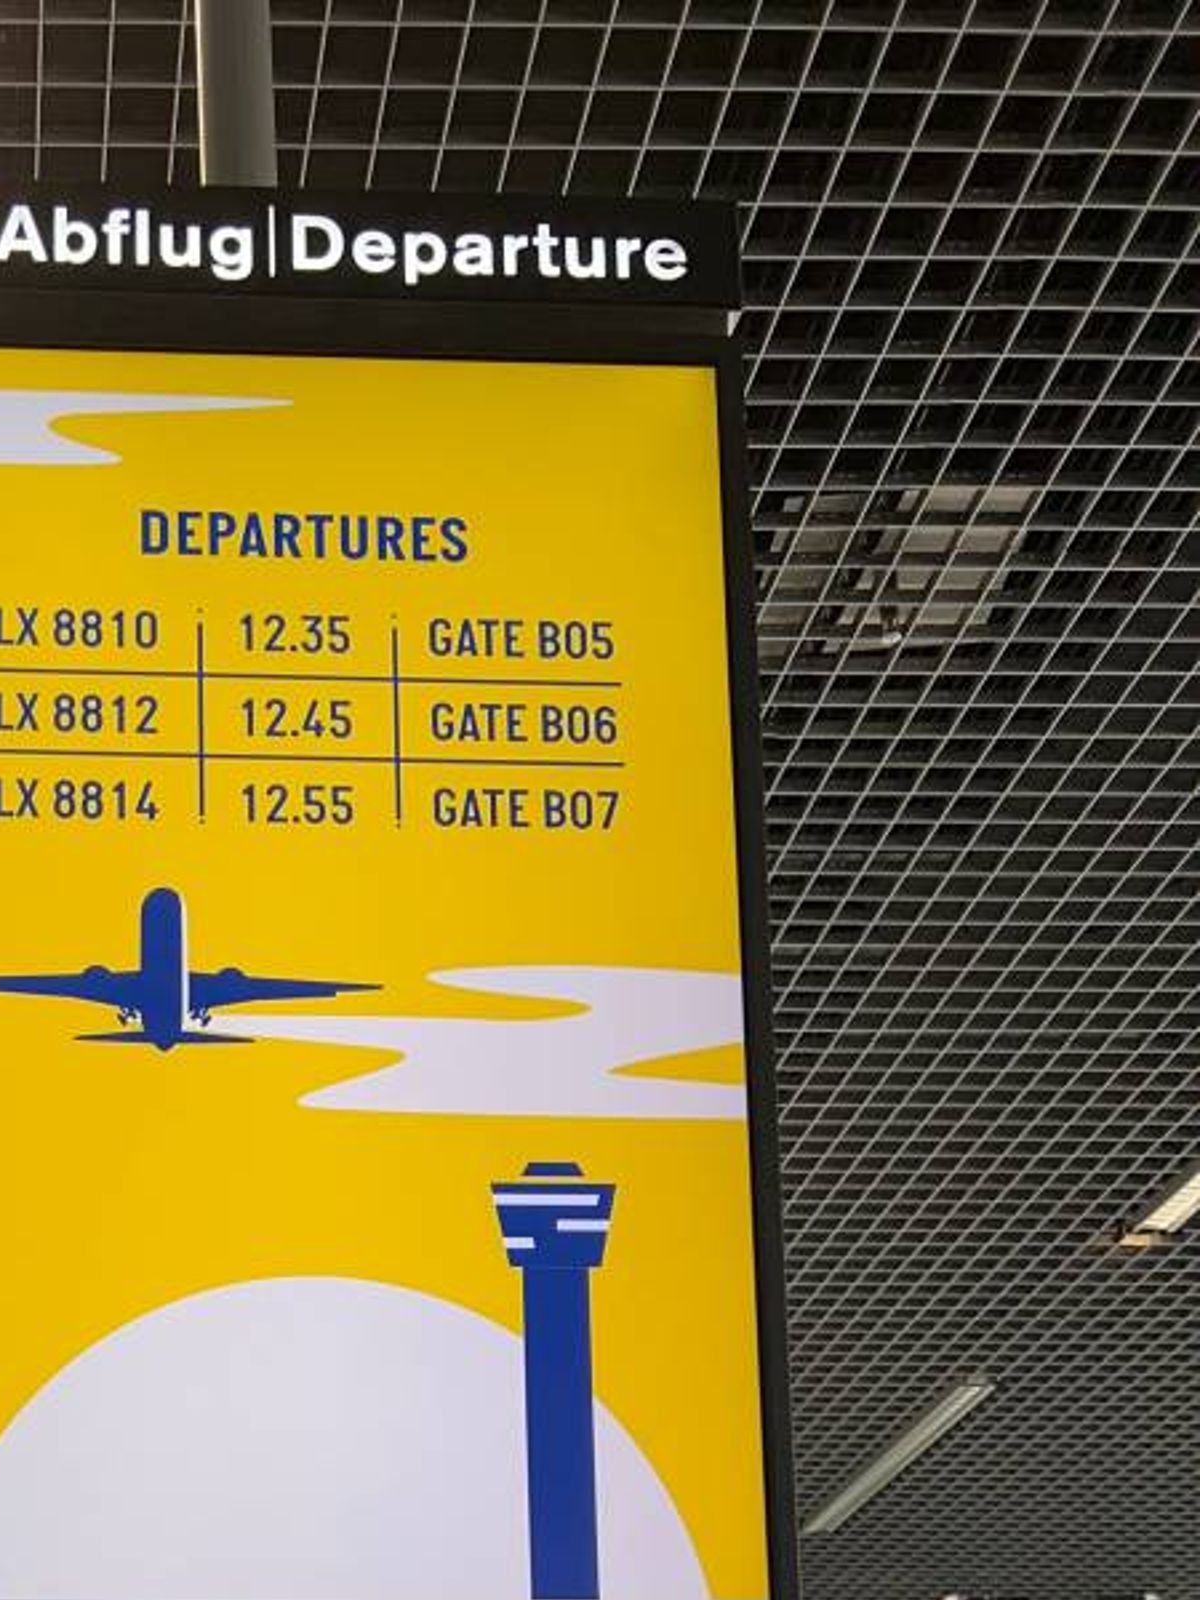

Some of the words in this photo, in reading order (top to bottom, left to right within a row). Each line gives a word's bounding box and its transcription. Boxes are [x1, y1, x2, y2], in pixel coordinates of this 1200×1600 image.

[291, 213, 689, 285] Departure
[139, 508, 469, 563] DEPARTURES
[54, 608, 158, 649] 8810
[240, 613, 350, 654] 12.35
[429, 617, 524, 658] GATE
[54, 693, 158, 734] 8812
[242, 698, 352, 739] 12.45
[431, 702, 527, 742] GATE
[54, 779, 159, 821] 8814
[242, 784, 353, 825] 12.55
[433, 788, 529, 828] GATE
